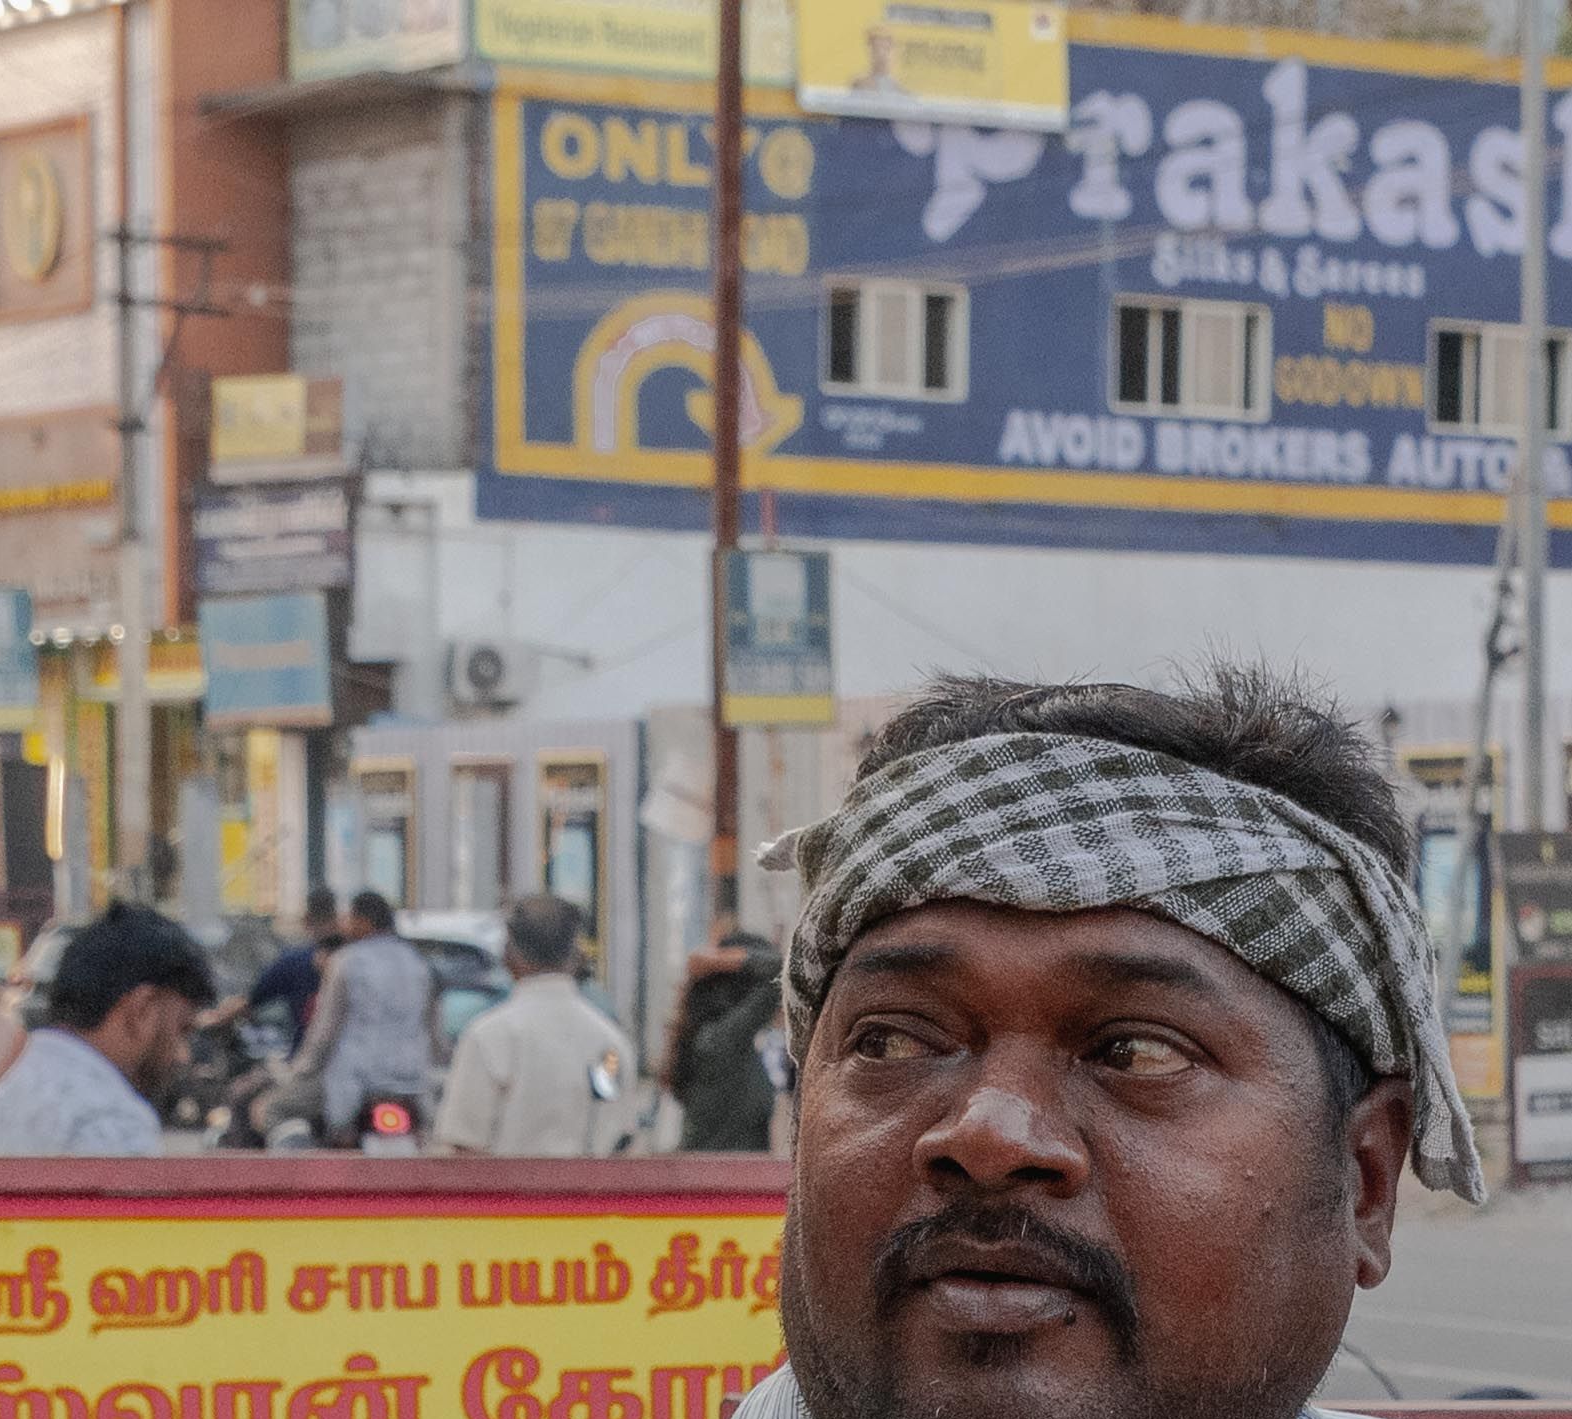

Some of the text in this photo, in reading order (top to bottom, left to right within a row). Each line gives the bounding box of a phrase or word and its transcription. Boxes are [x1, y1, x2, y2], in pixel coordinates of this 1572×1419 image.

[998, 409, 1146, 468] AVOID
[1154, 420, 1372, 482] BROKERS
[88, 1249, 268, 1337] ஹரி
[287, 1261, 439, 1313] சாப
[460, 1240, 632, 1310] பயம்
